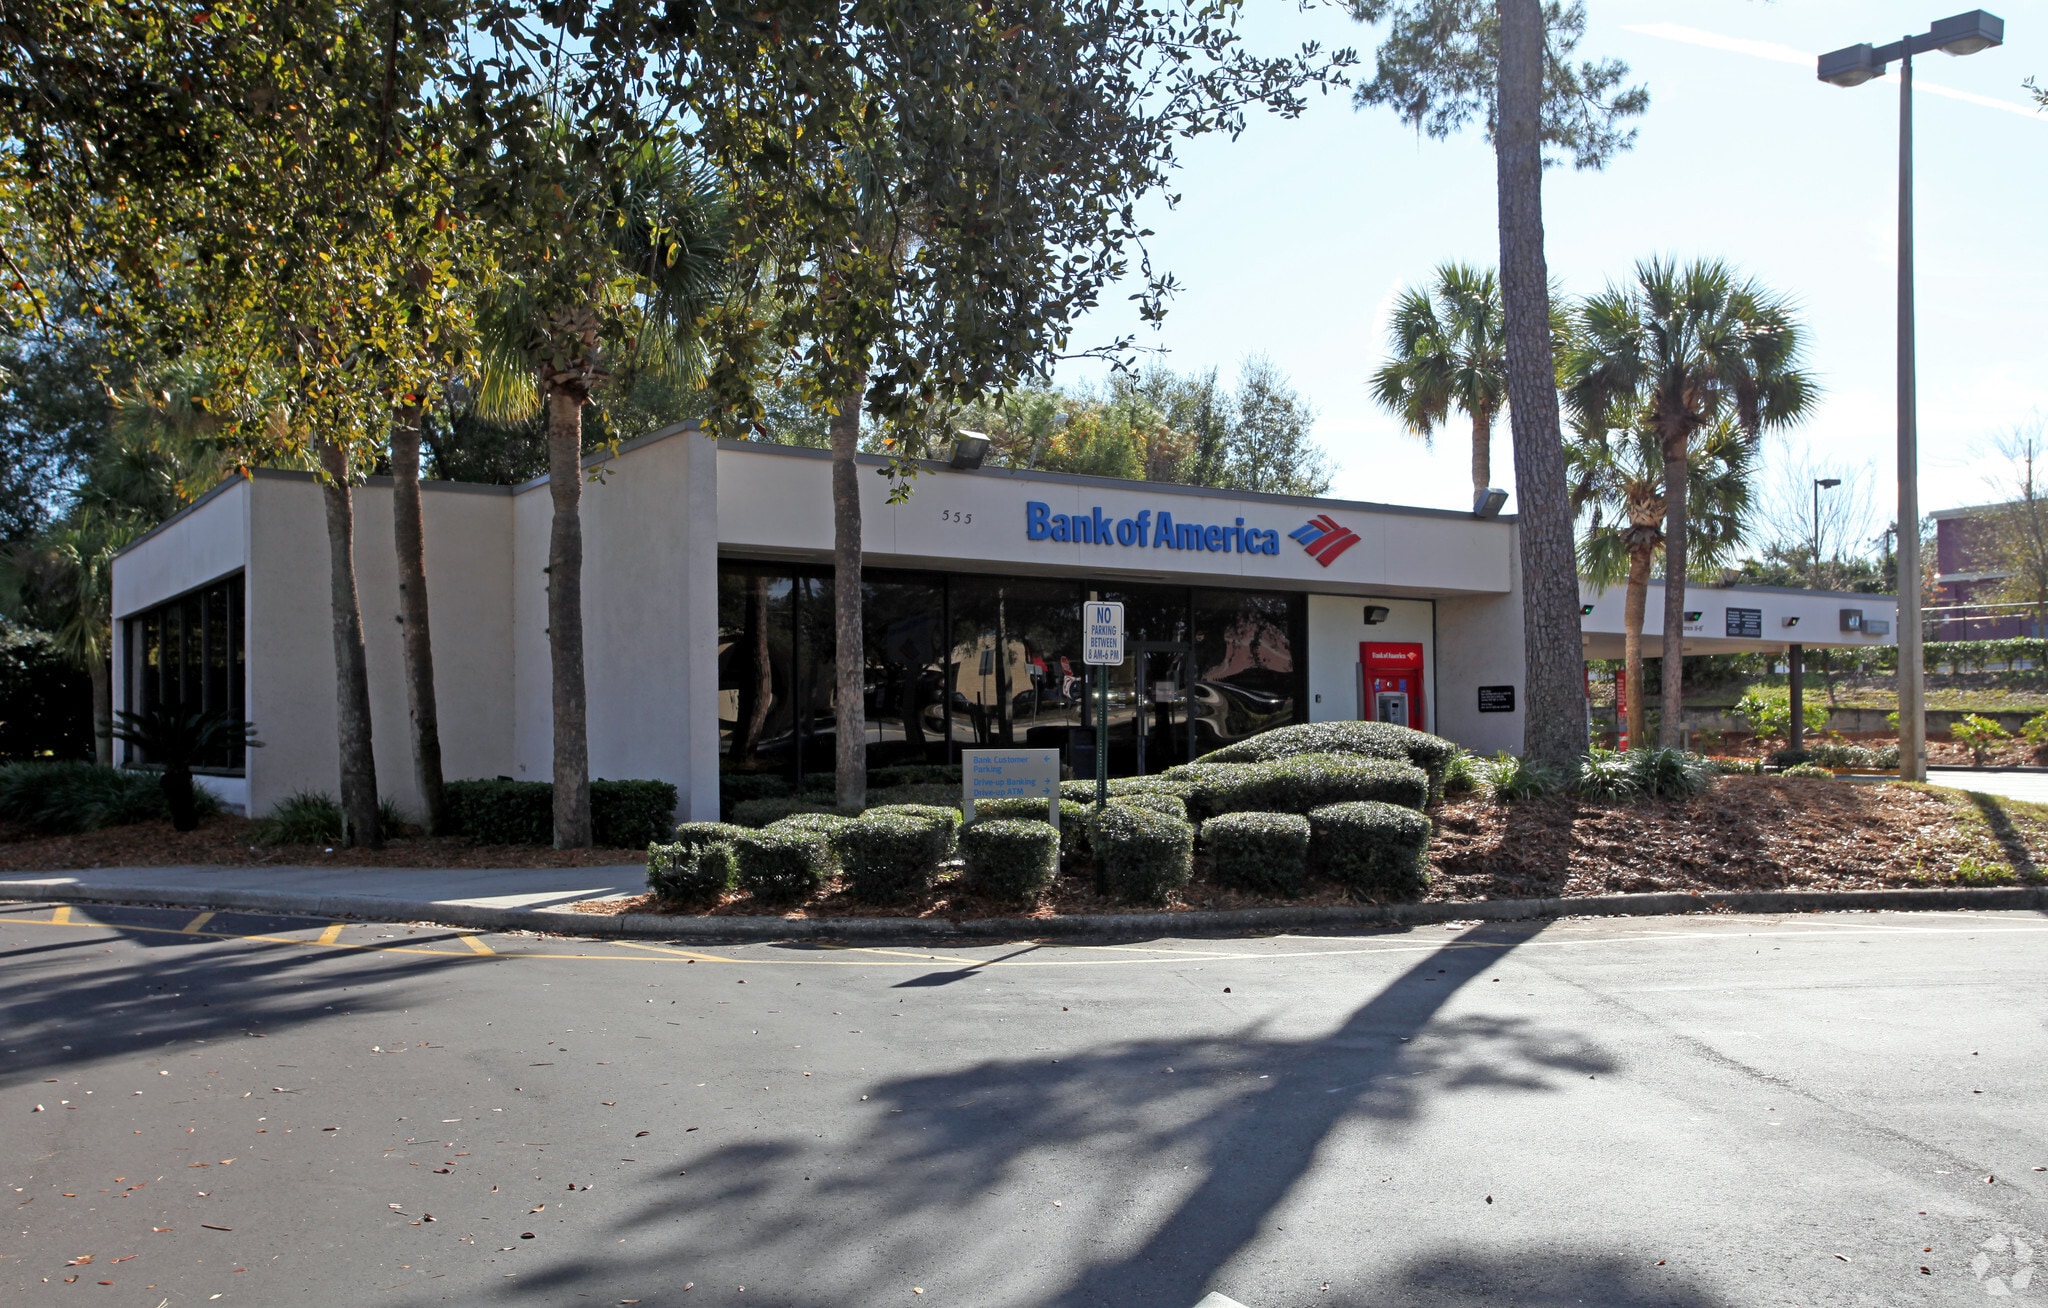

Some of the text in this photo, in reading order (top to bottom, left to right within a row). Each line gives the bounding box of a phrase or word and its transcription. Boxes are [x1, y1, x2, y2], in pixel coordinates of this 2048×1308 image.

[942, 509, 972, 525] 555
[1026, 501, 1280, 556] Bank of America
[1097, 607, 1111, 623] NO
[1092, 625, 1116, 635] PARKING
[1091, 637, 1117, 647] BETWEEN
[1088, 649, 1092, 659] 8
[1110, 650, 1119, 660] PM
[973, 756, 1028, 764] Bank Customer
[973, 765, 1002, 774] Parking
[973, 778, 1036, 787] Drive-up Banking
[973, 788, 1006, 797] Drive-up
